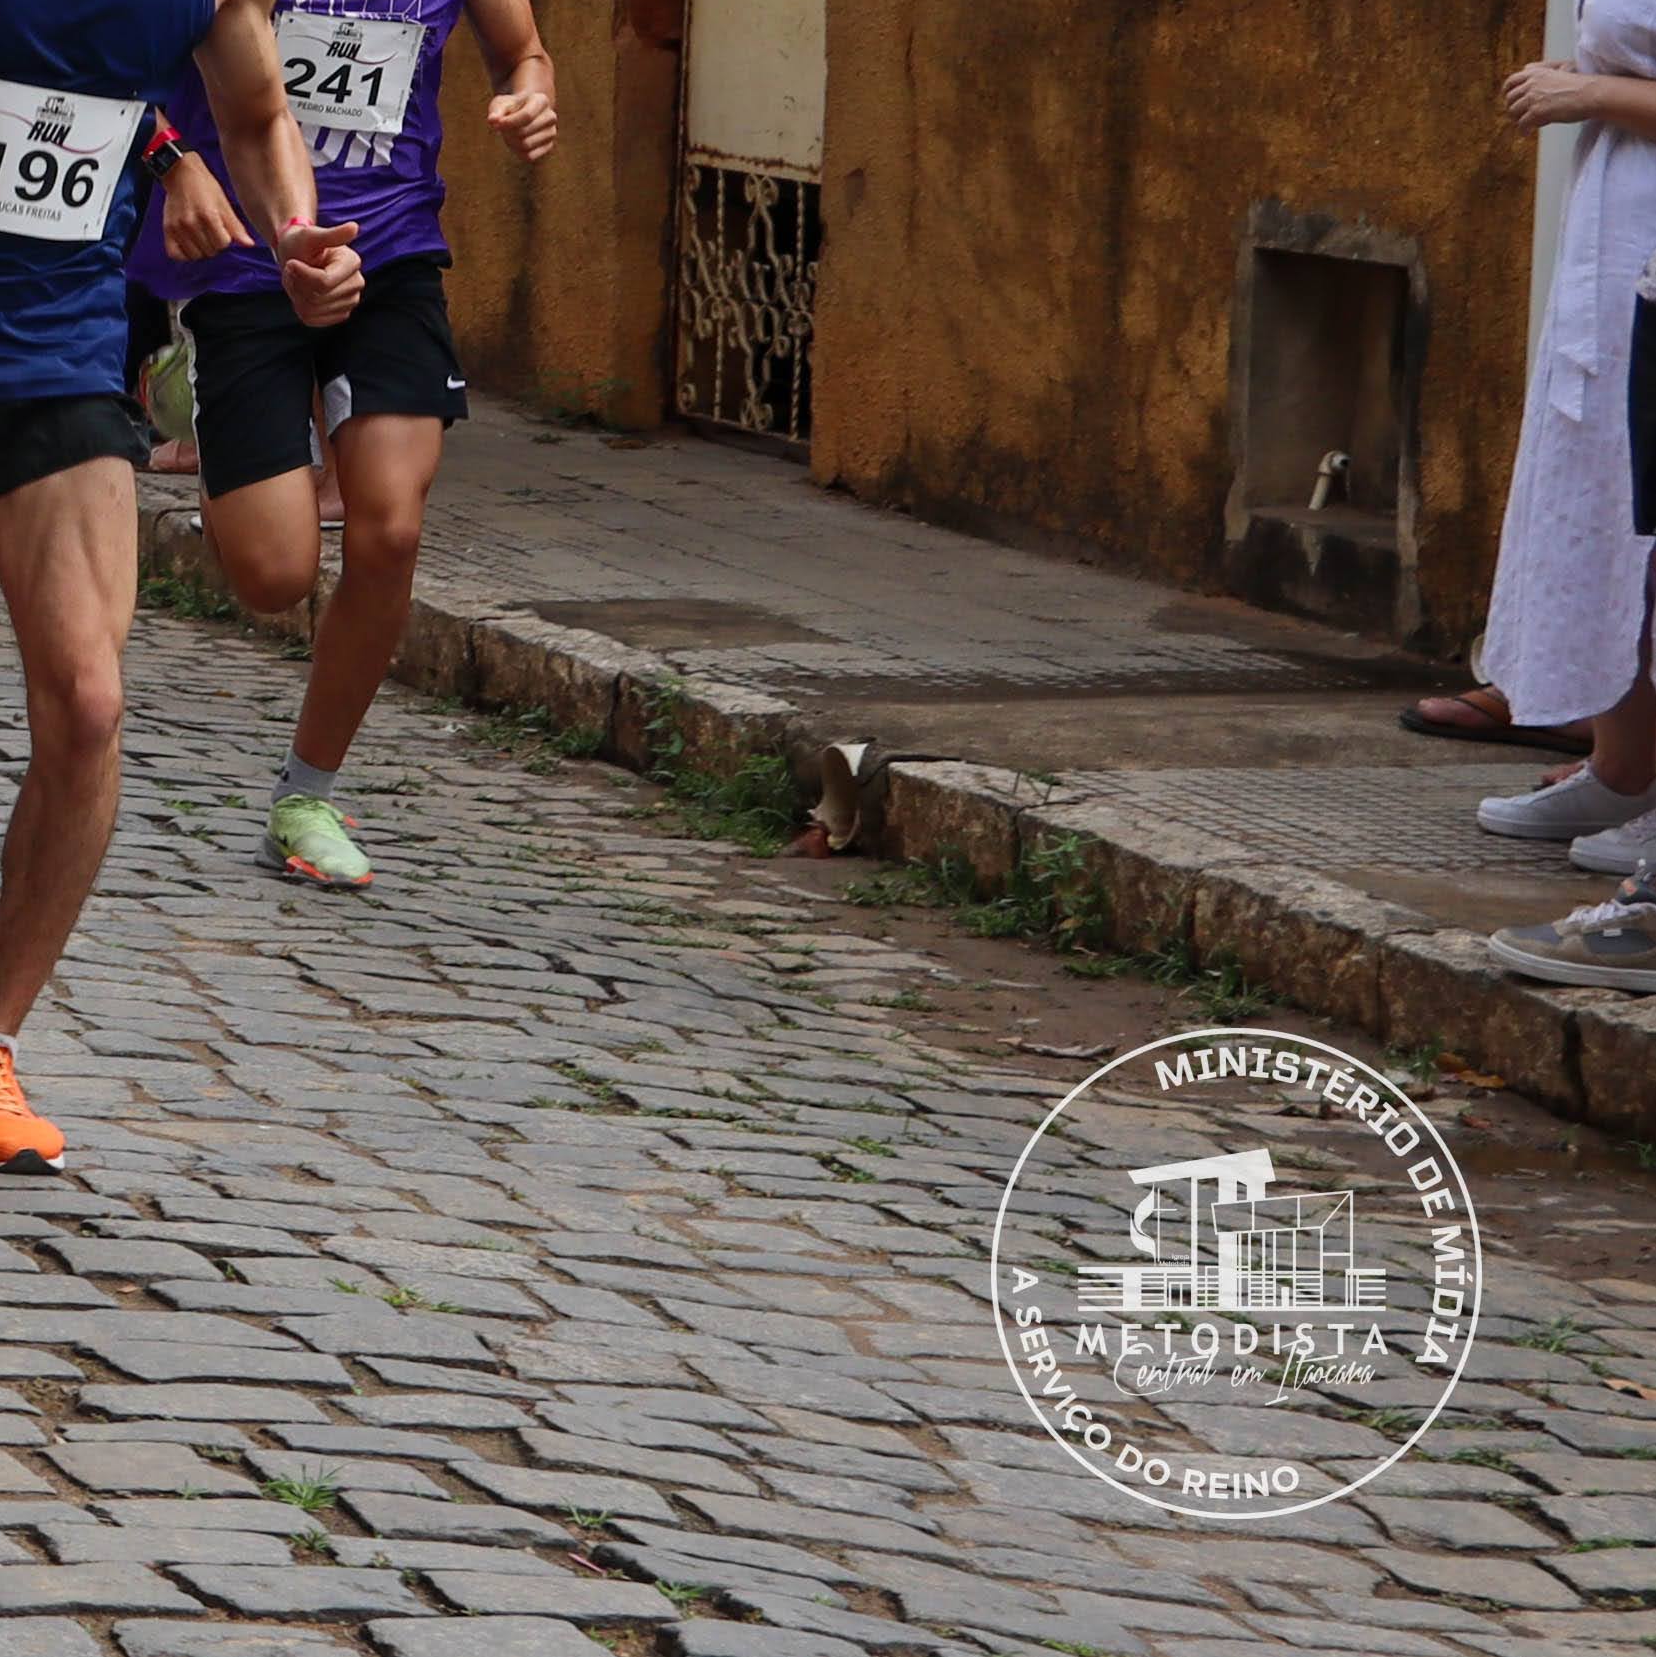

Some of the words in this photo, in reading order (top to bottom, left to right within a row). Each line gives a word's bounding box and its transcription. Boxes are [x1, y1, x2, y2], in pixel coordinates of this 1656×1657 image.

[326, 41, 361, 60] RUN
[284, 57, 385, 107] 241
[297, 101, 325, 113] PEDRO
[326, 106, 363, 118] MACHADO
[27, 121, 72, 147] RUN
[25, 205, 63, 222] FREITAS
